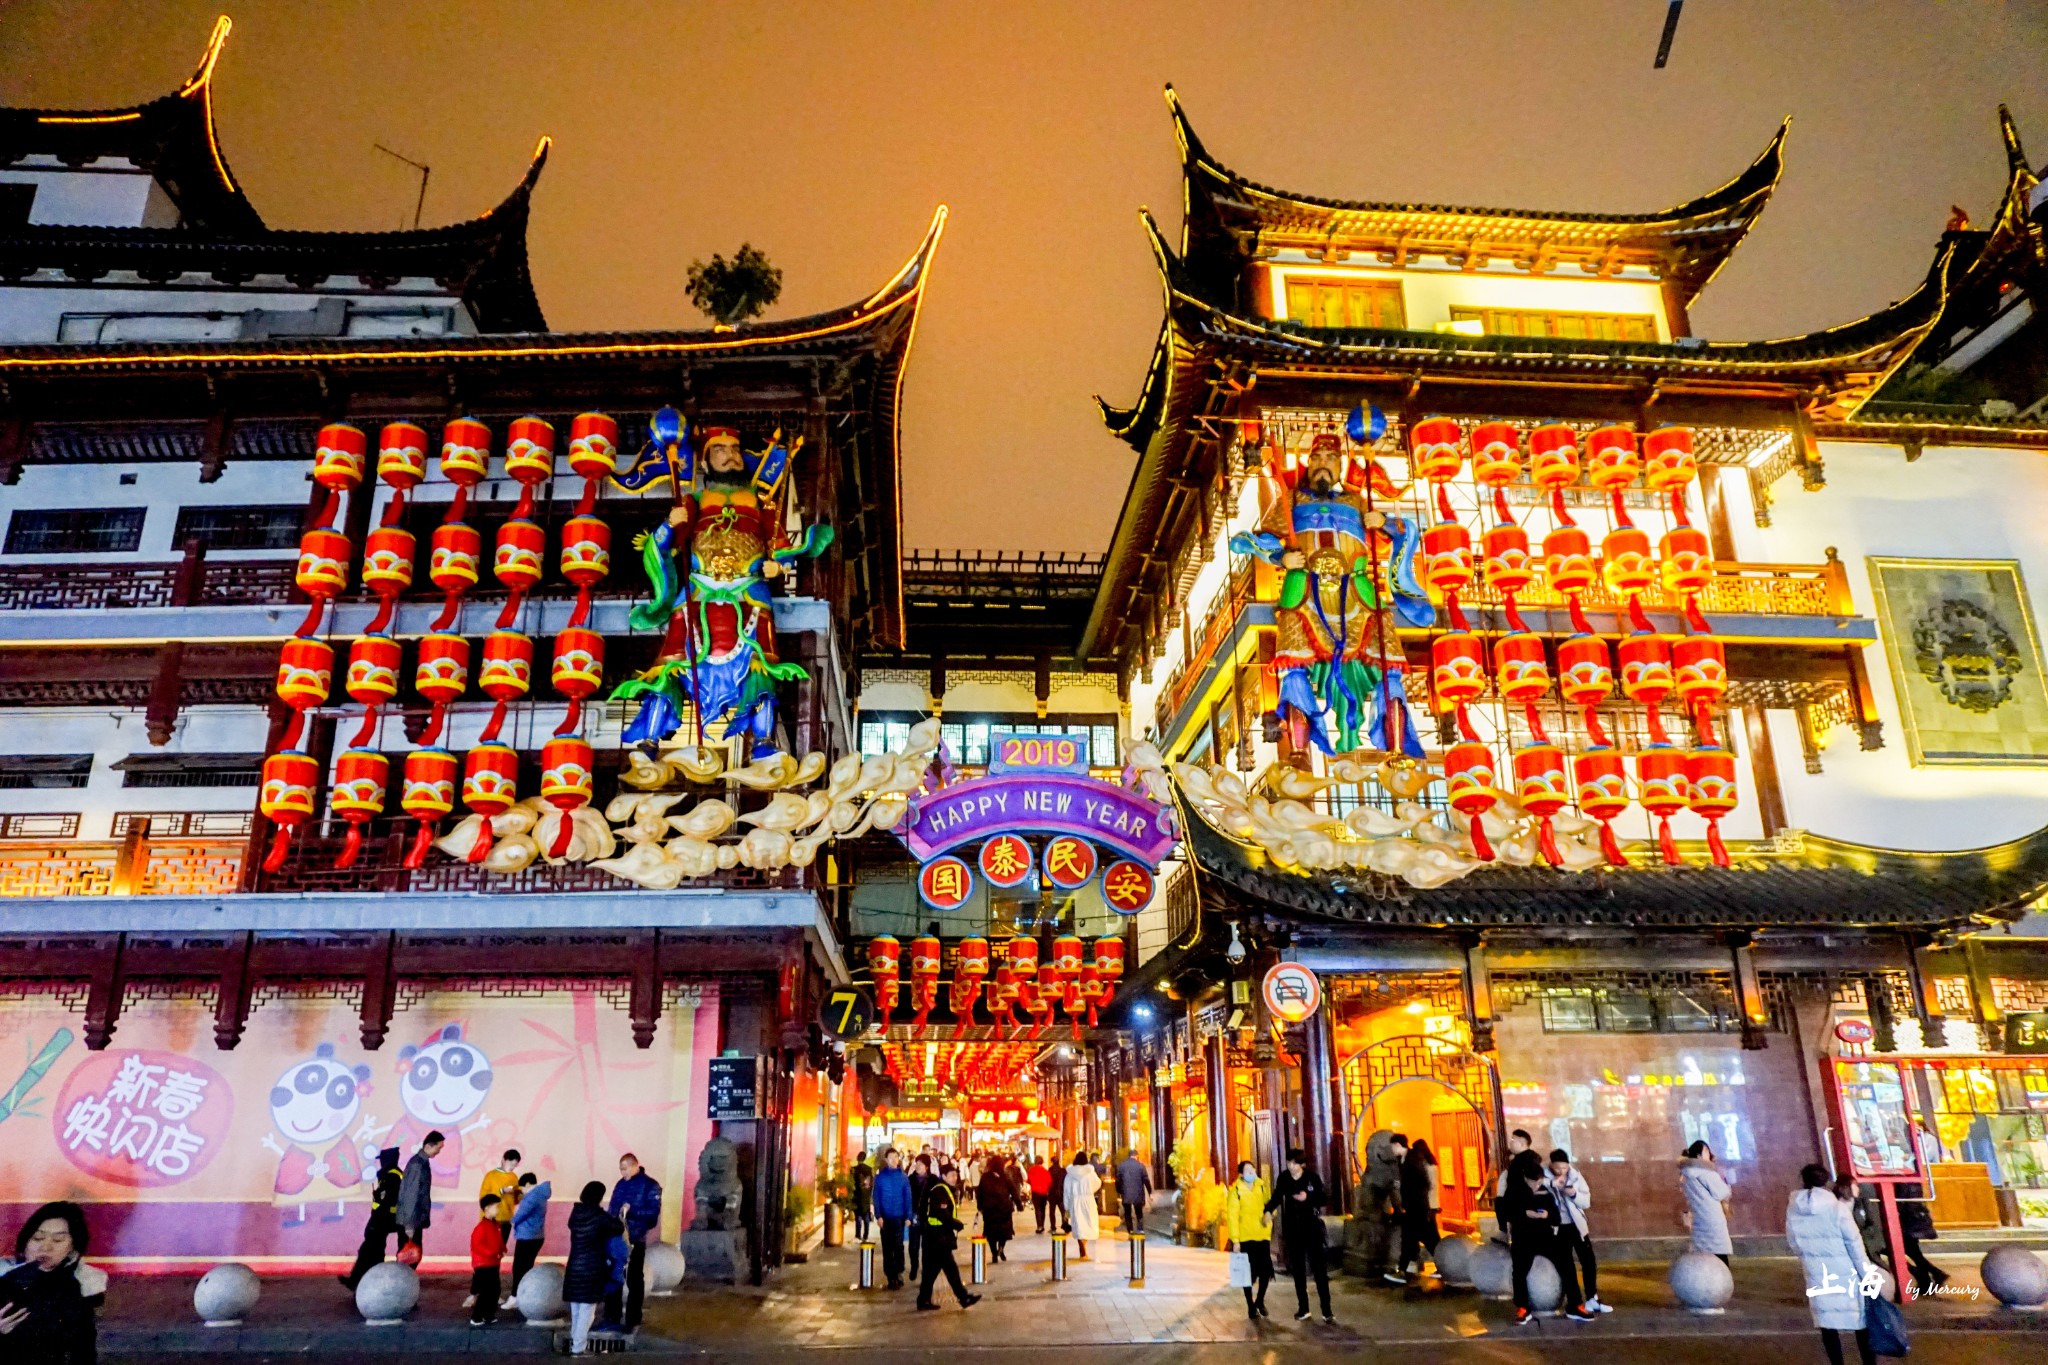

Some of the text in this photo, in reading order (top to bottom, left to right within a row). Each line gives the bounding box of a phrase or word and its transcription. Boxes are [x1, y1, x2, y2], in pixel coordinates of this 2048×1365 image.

[1005, 739, 1076, 767] 2019
[928, 790, 1147, 839] HAPPY NEW YEAR
[931, 836, 1147, 904] 国泰民安
[830, 991, 857, 1034] 7
[107, 1054, 208, 1120] 新春
[63, 1095, 205, 1176] 快闪店
